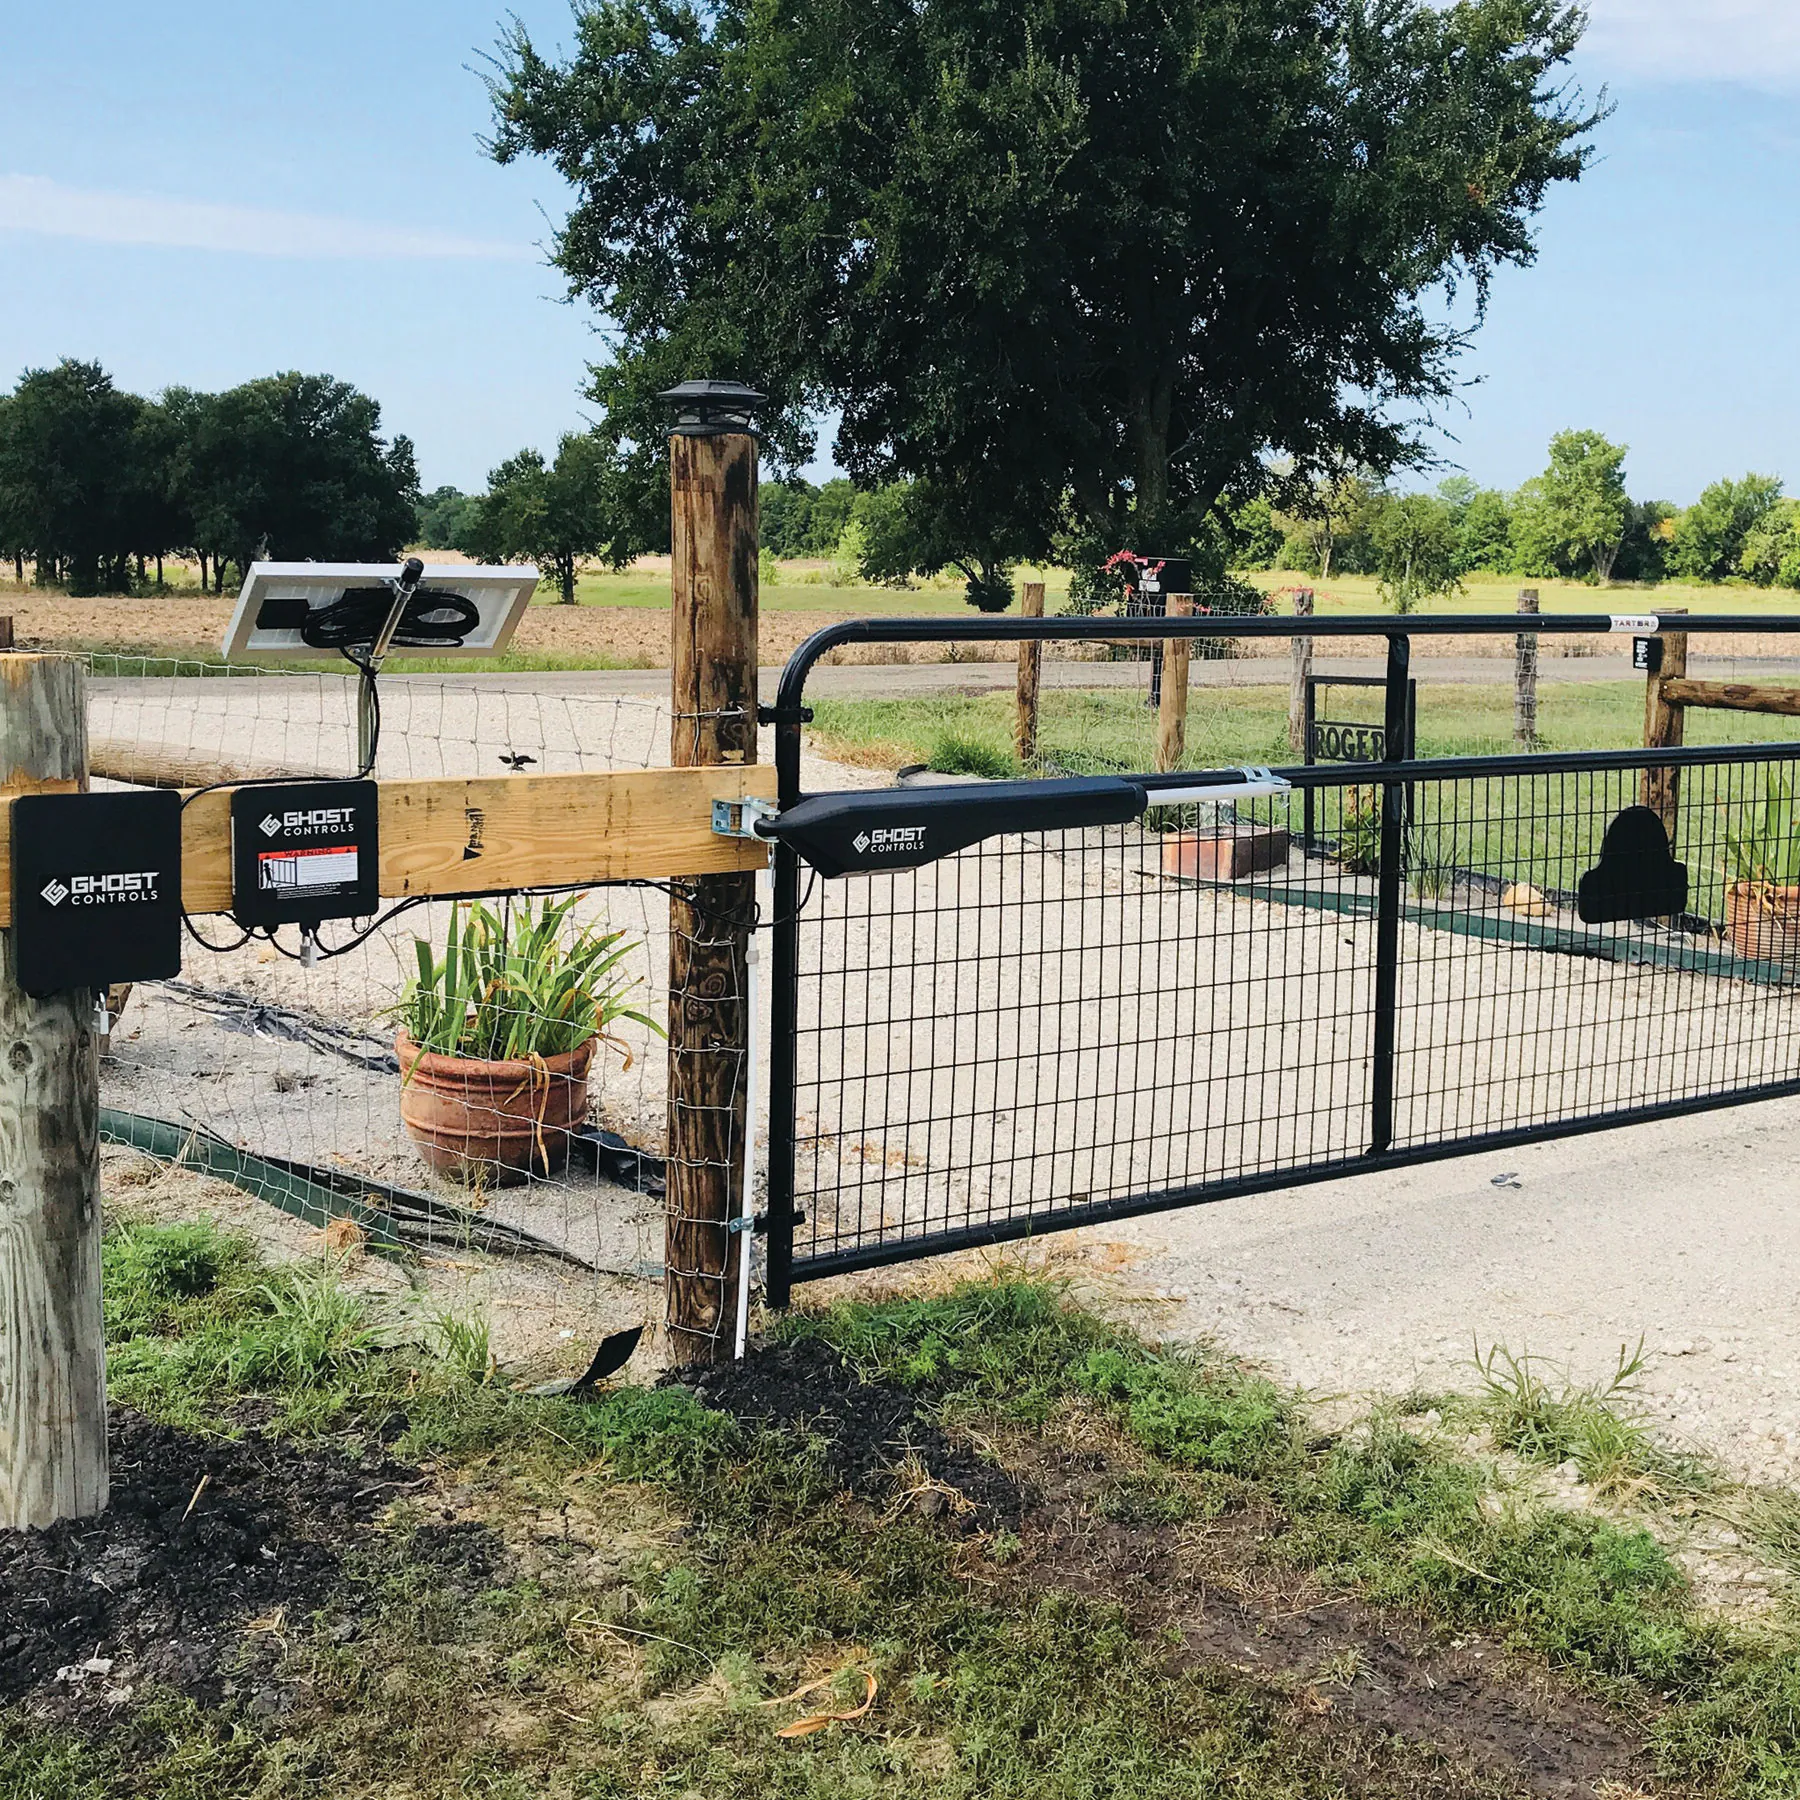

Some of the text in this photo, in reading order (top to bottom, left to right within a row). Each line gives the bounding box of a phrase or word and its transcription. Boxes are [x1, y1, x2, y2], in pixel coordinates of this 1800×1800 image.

[283, 808, 356, 826] GHOST
[283, 824, 354, 836] CONTROLS
[871, 826, 927, 844] GHOST
[870, 841, 924, 853] CONTROLS
[71, 872, 159, 894] GHOST
[71, 890, 158, 905] CONTROLS
